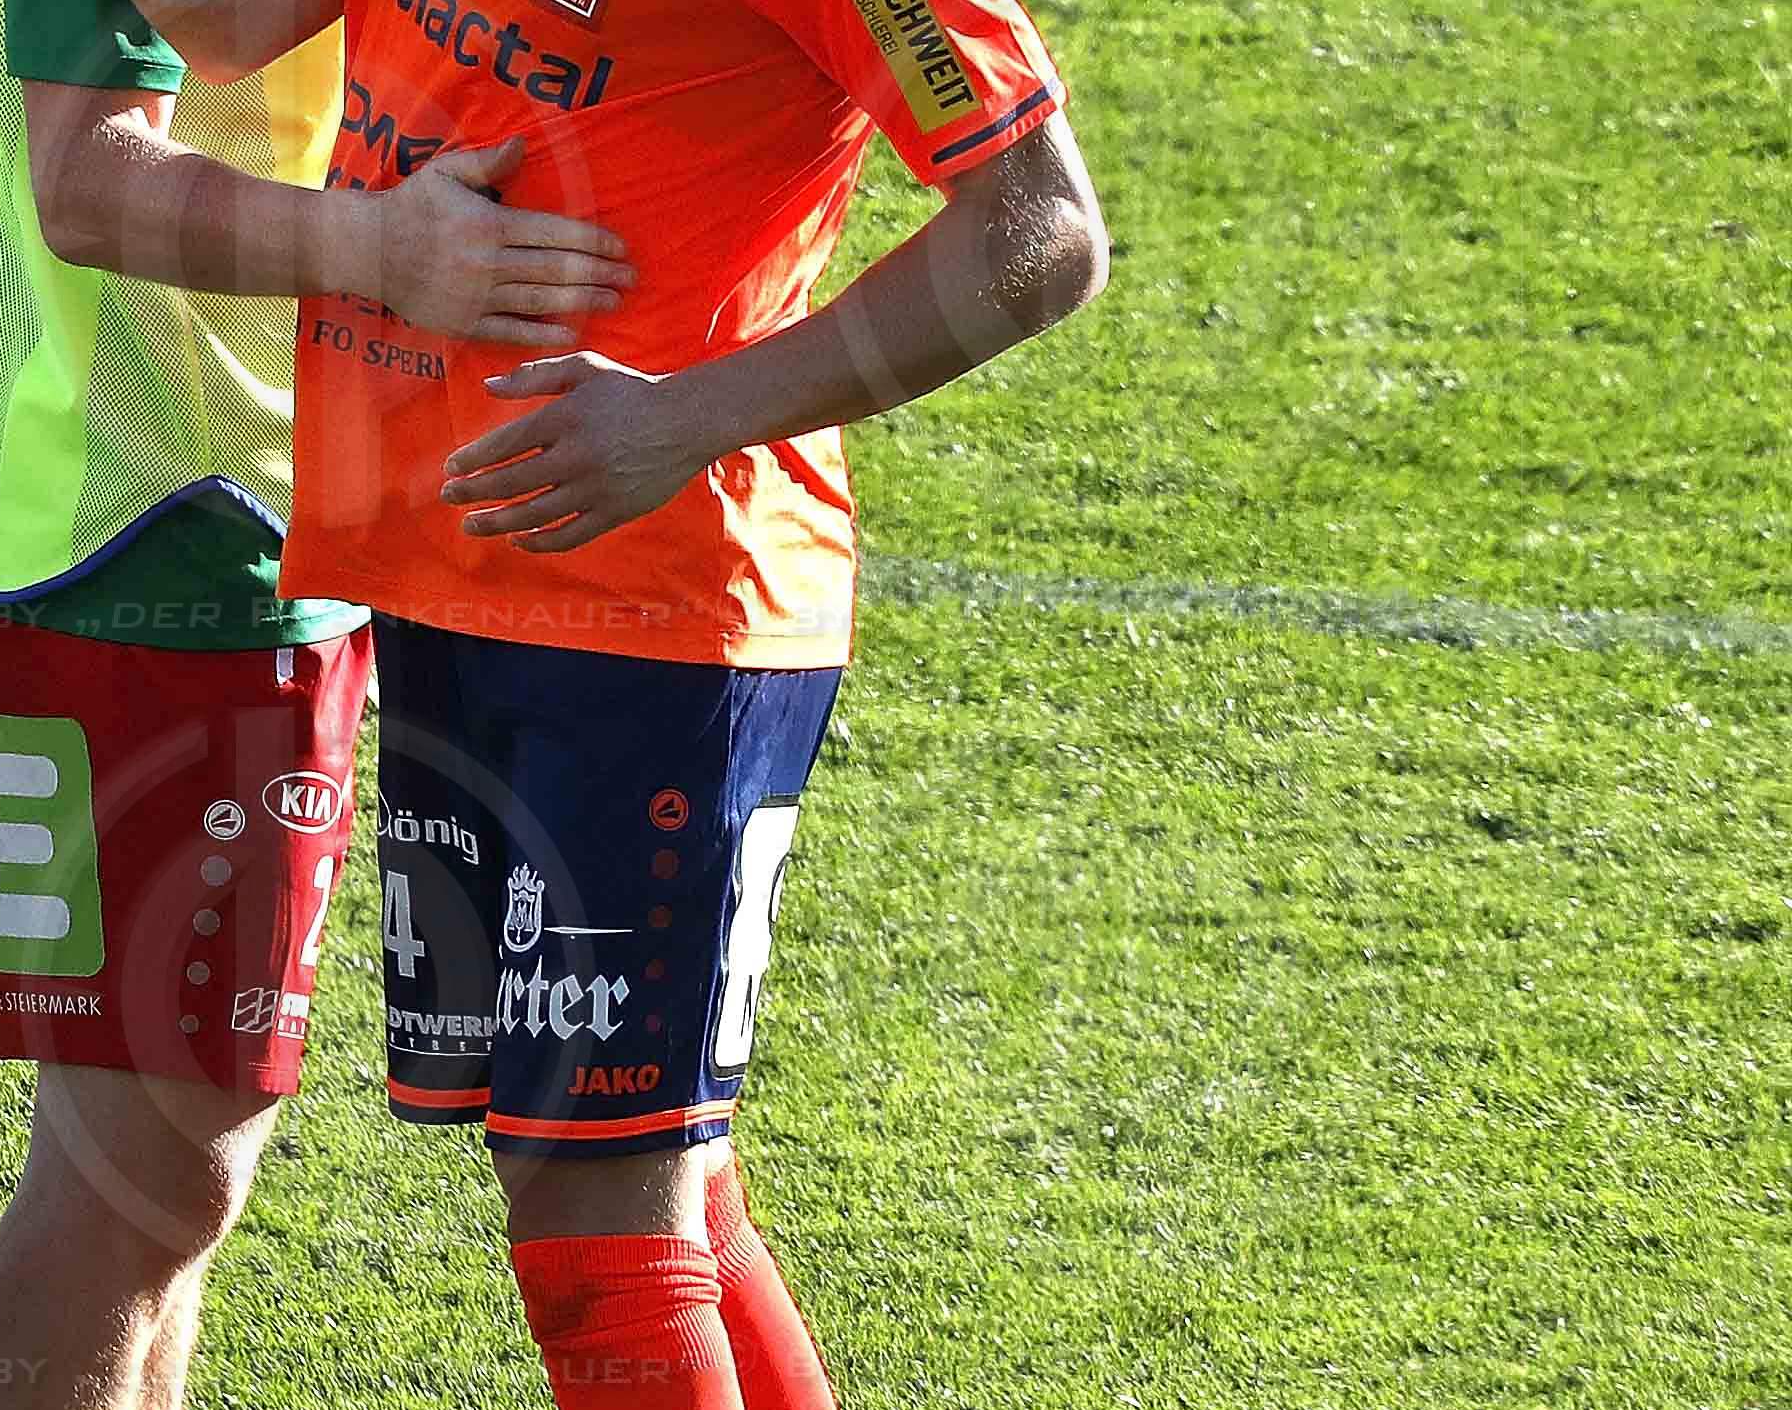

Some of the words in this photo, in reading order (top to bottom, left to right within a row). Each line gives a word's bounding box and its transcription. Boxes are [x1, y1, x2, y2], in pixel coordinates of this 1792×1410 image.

[280, 781, 335, 822] KIA
[383, 869, 426, 979] 4
[4, 991, 103, 1017] STEIERMARK
[496, 954, 631, 1042] rter
[568, 1063, 663, 1096] JAKO
